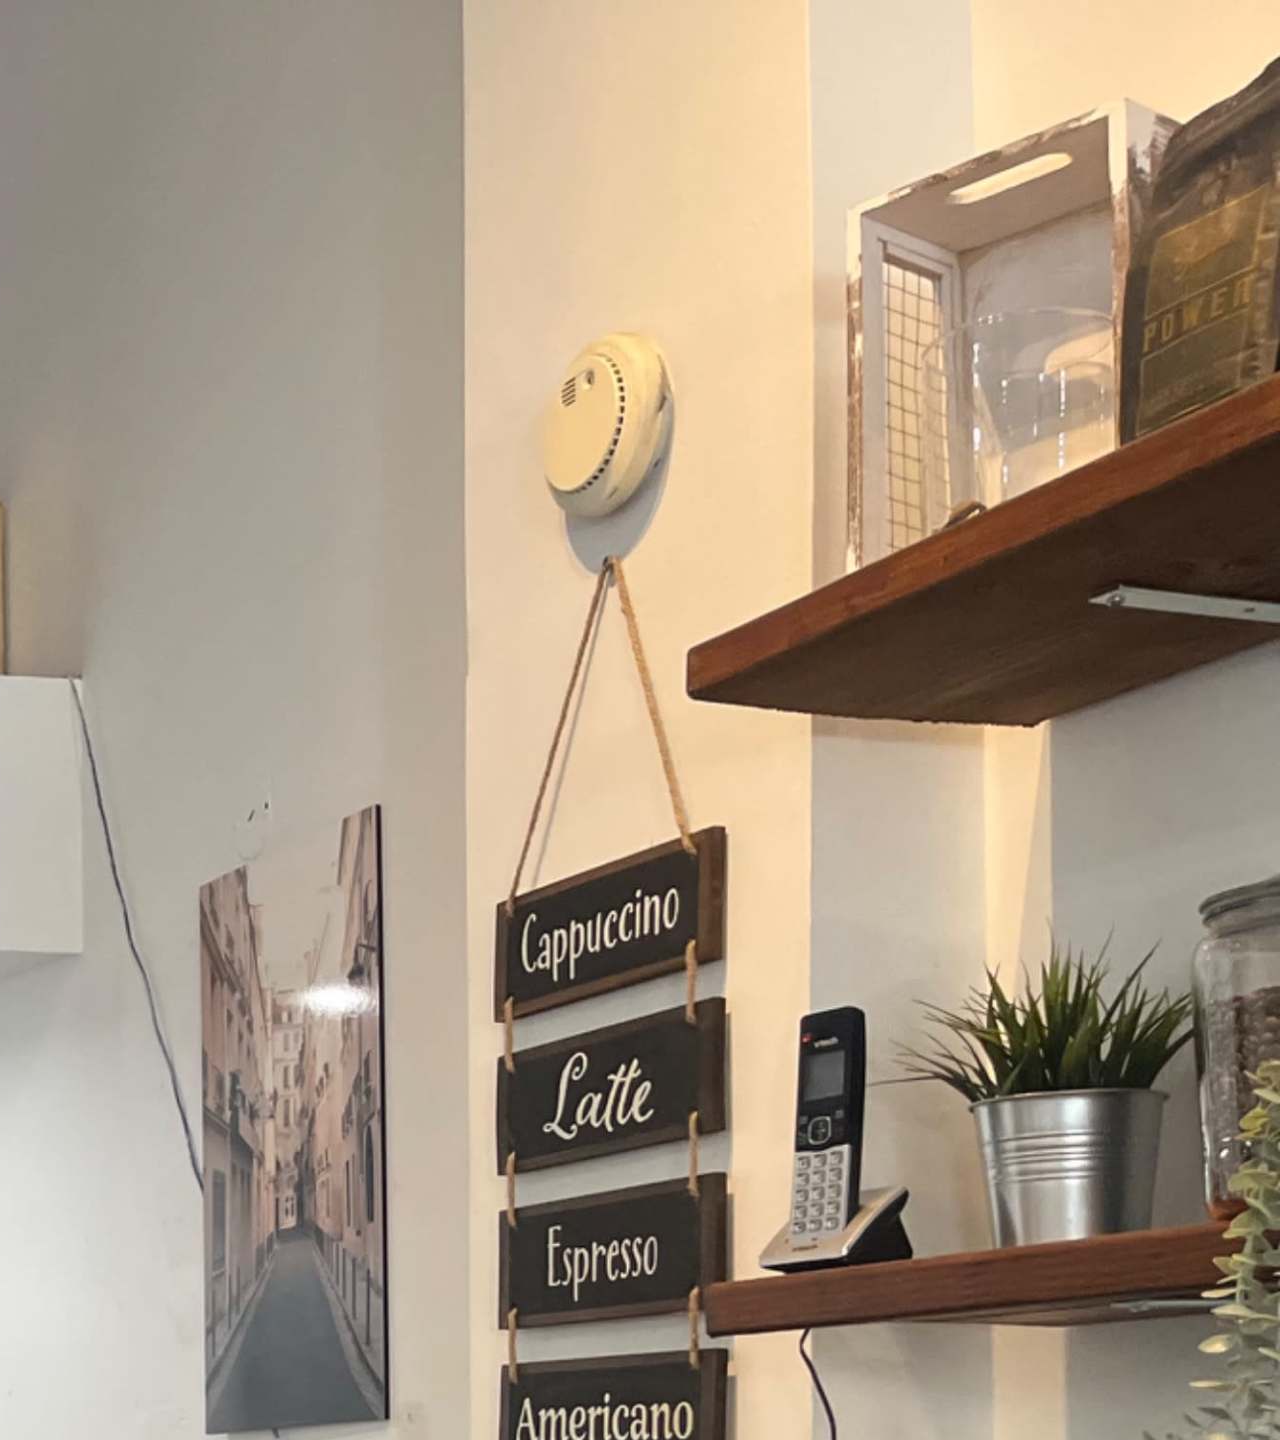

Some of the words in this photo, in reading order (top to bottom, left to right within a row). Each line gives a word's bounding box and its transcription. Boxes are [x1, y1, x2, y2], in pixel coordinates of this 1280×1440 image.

[1142, 272, 1256, 354] POWER
[521, 887, 680, 982] Cappuccino
[542, 1052, 655, 1140] Latte
[547, 1225, 658, 1302] Espresso
